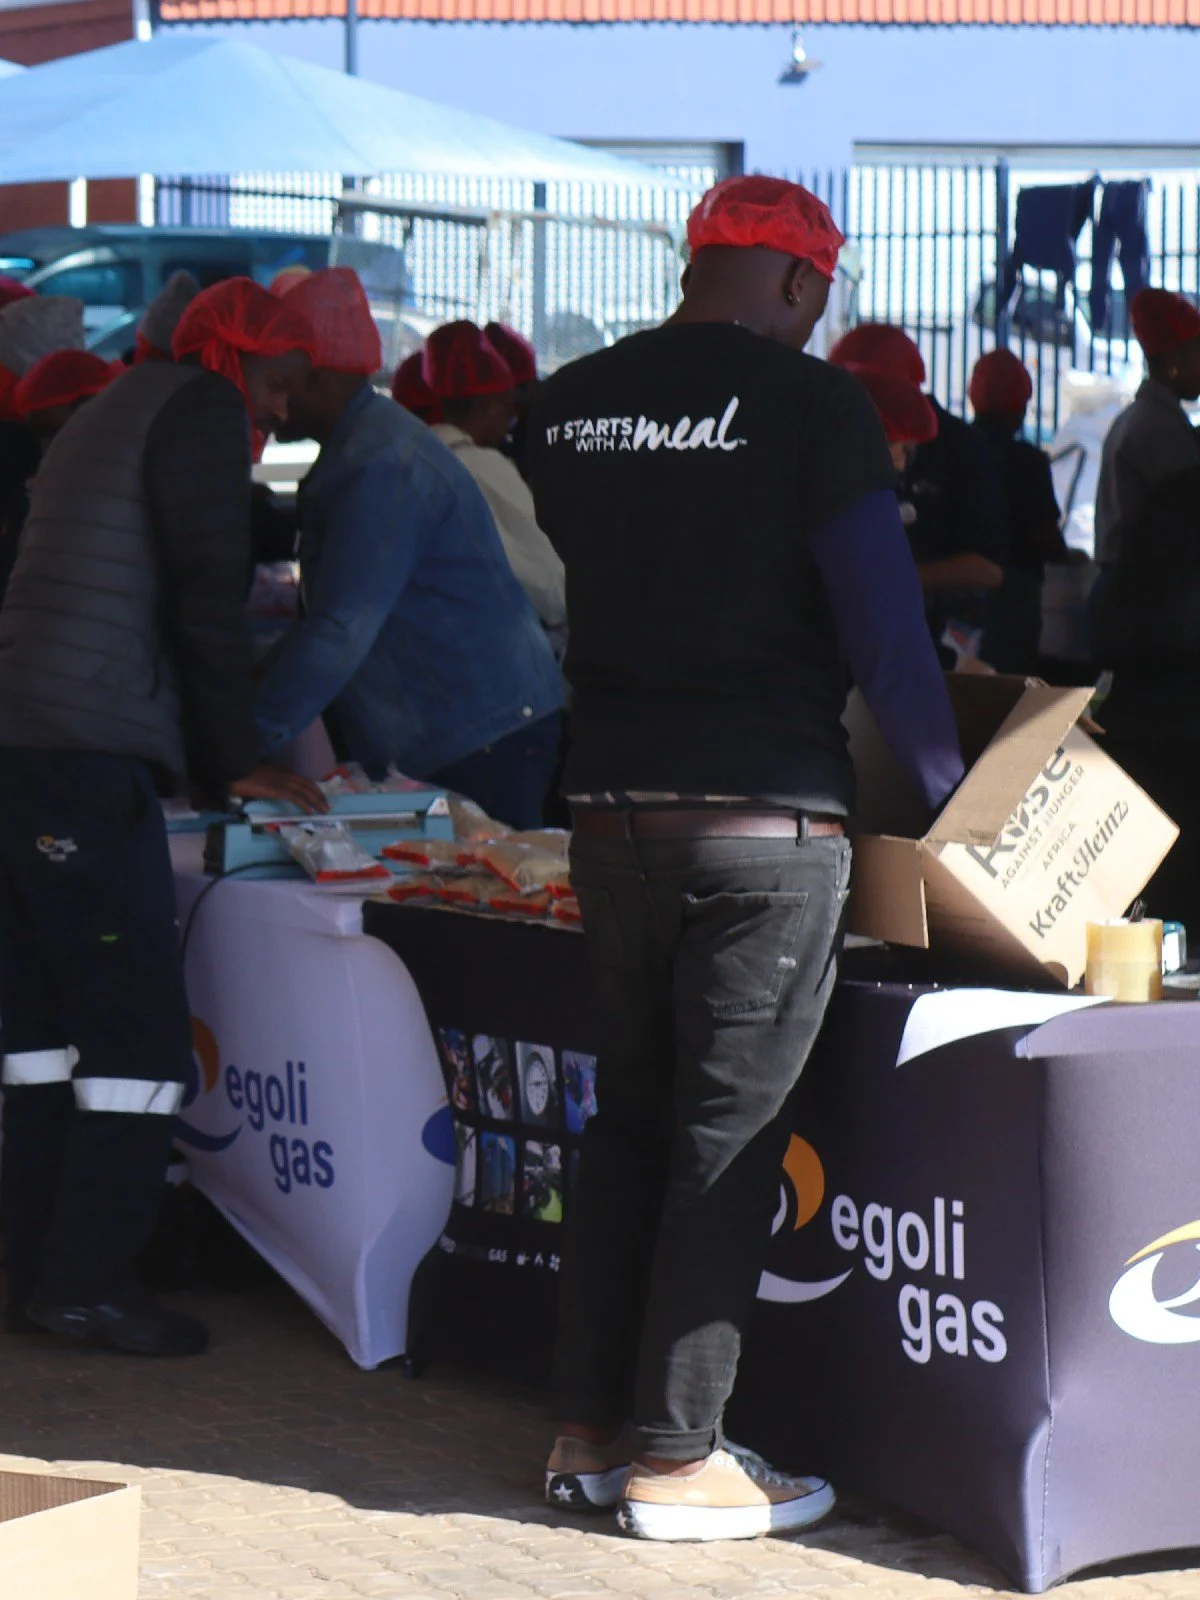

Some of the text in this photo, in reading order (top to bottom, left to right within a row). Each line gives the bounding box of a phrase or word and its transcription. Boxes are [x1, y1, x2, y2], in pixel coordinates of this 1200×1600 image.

[546, 416, 633, 446] IT STARTS
[575, 435, 634, 453] WITH A
[1001, 827, 1044, 890] AGAINST
[1041, 821, 1079, 872] AFRICA
[225, 1060, 309, 1132] egoli
[270, 1133, 334, 1195] gas
[831, 1194, 965, 1281] egoli
[897, 1283, 1009, 1365] gas
